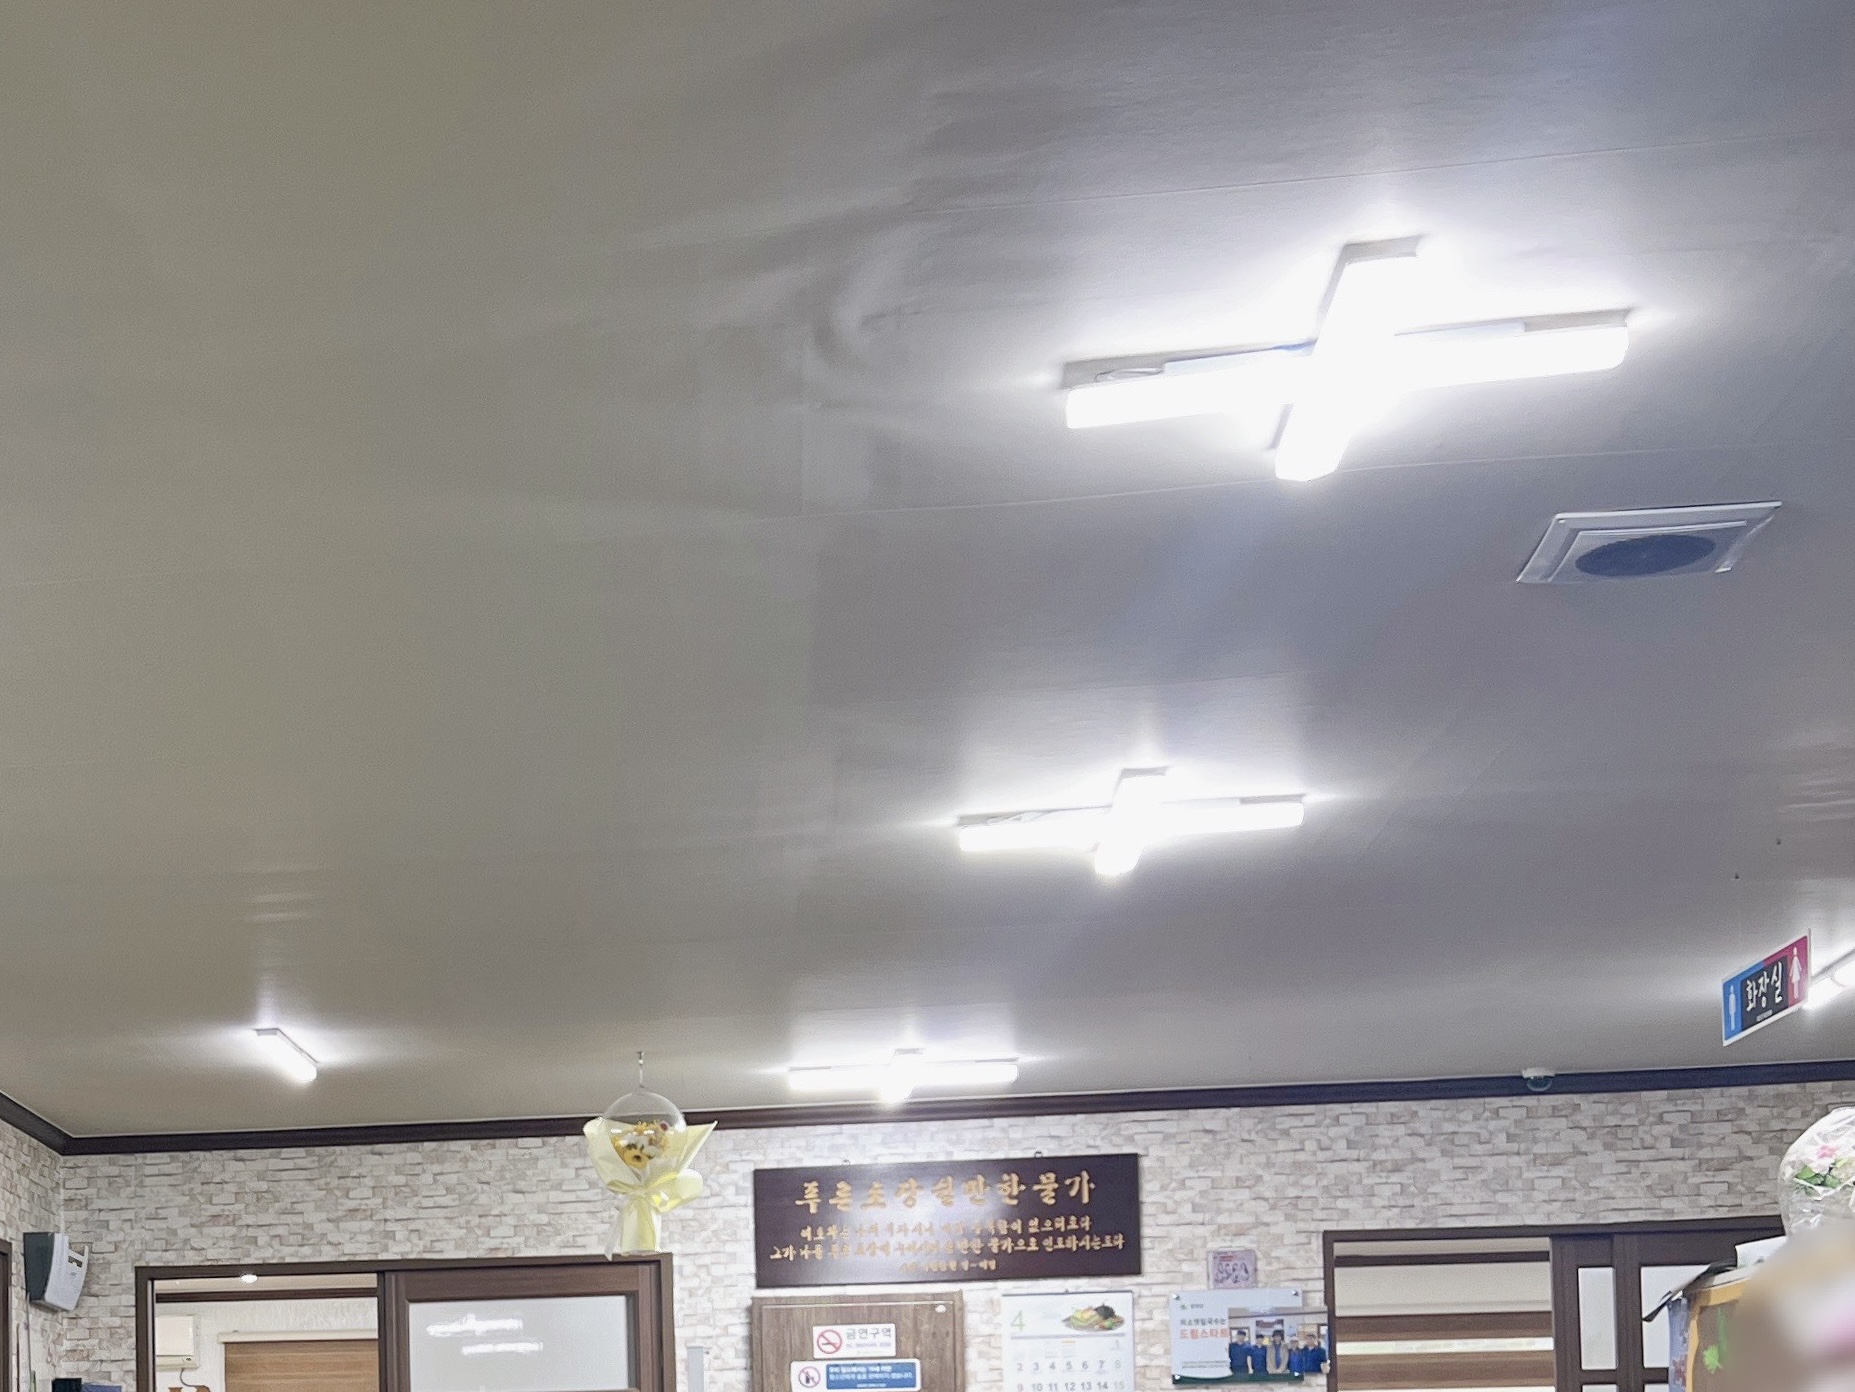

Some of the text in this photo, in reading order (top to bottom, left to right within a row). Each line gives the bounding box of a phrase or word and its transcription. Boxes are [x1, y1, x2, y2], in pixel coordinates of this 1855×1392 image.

[1746, 961, 1783, 1011] 화장실
[1010, 1310, 1026, 1331] 4
[846, 1327, 892, 1340] 금연구역
[1033, 1362, 1039, 1371] 3
[1049, 1362, 1056, 1370] 4
[1066, 1361, 1072, 1370] 5
[1082, 1360, 1088, 1369] 6
[1099, 1360, 1105, 1368] 7
[1032, 1383, 1043, 1391] 10
[1049, 1383, 1058, 1391] 11
[1065, 1383, 1075, 1391] 12
[1081, 1382, 1091, 1390] 13
[1097, 1382, 1108, 1390] 14
